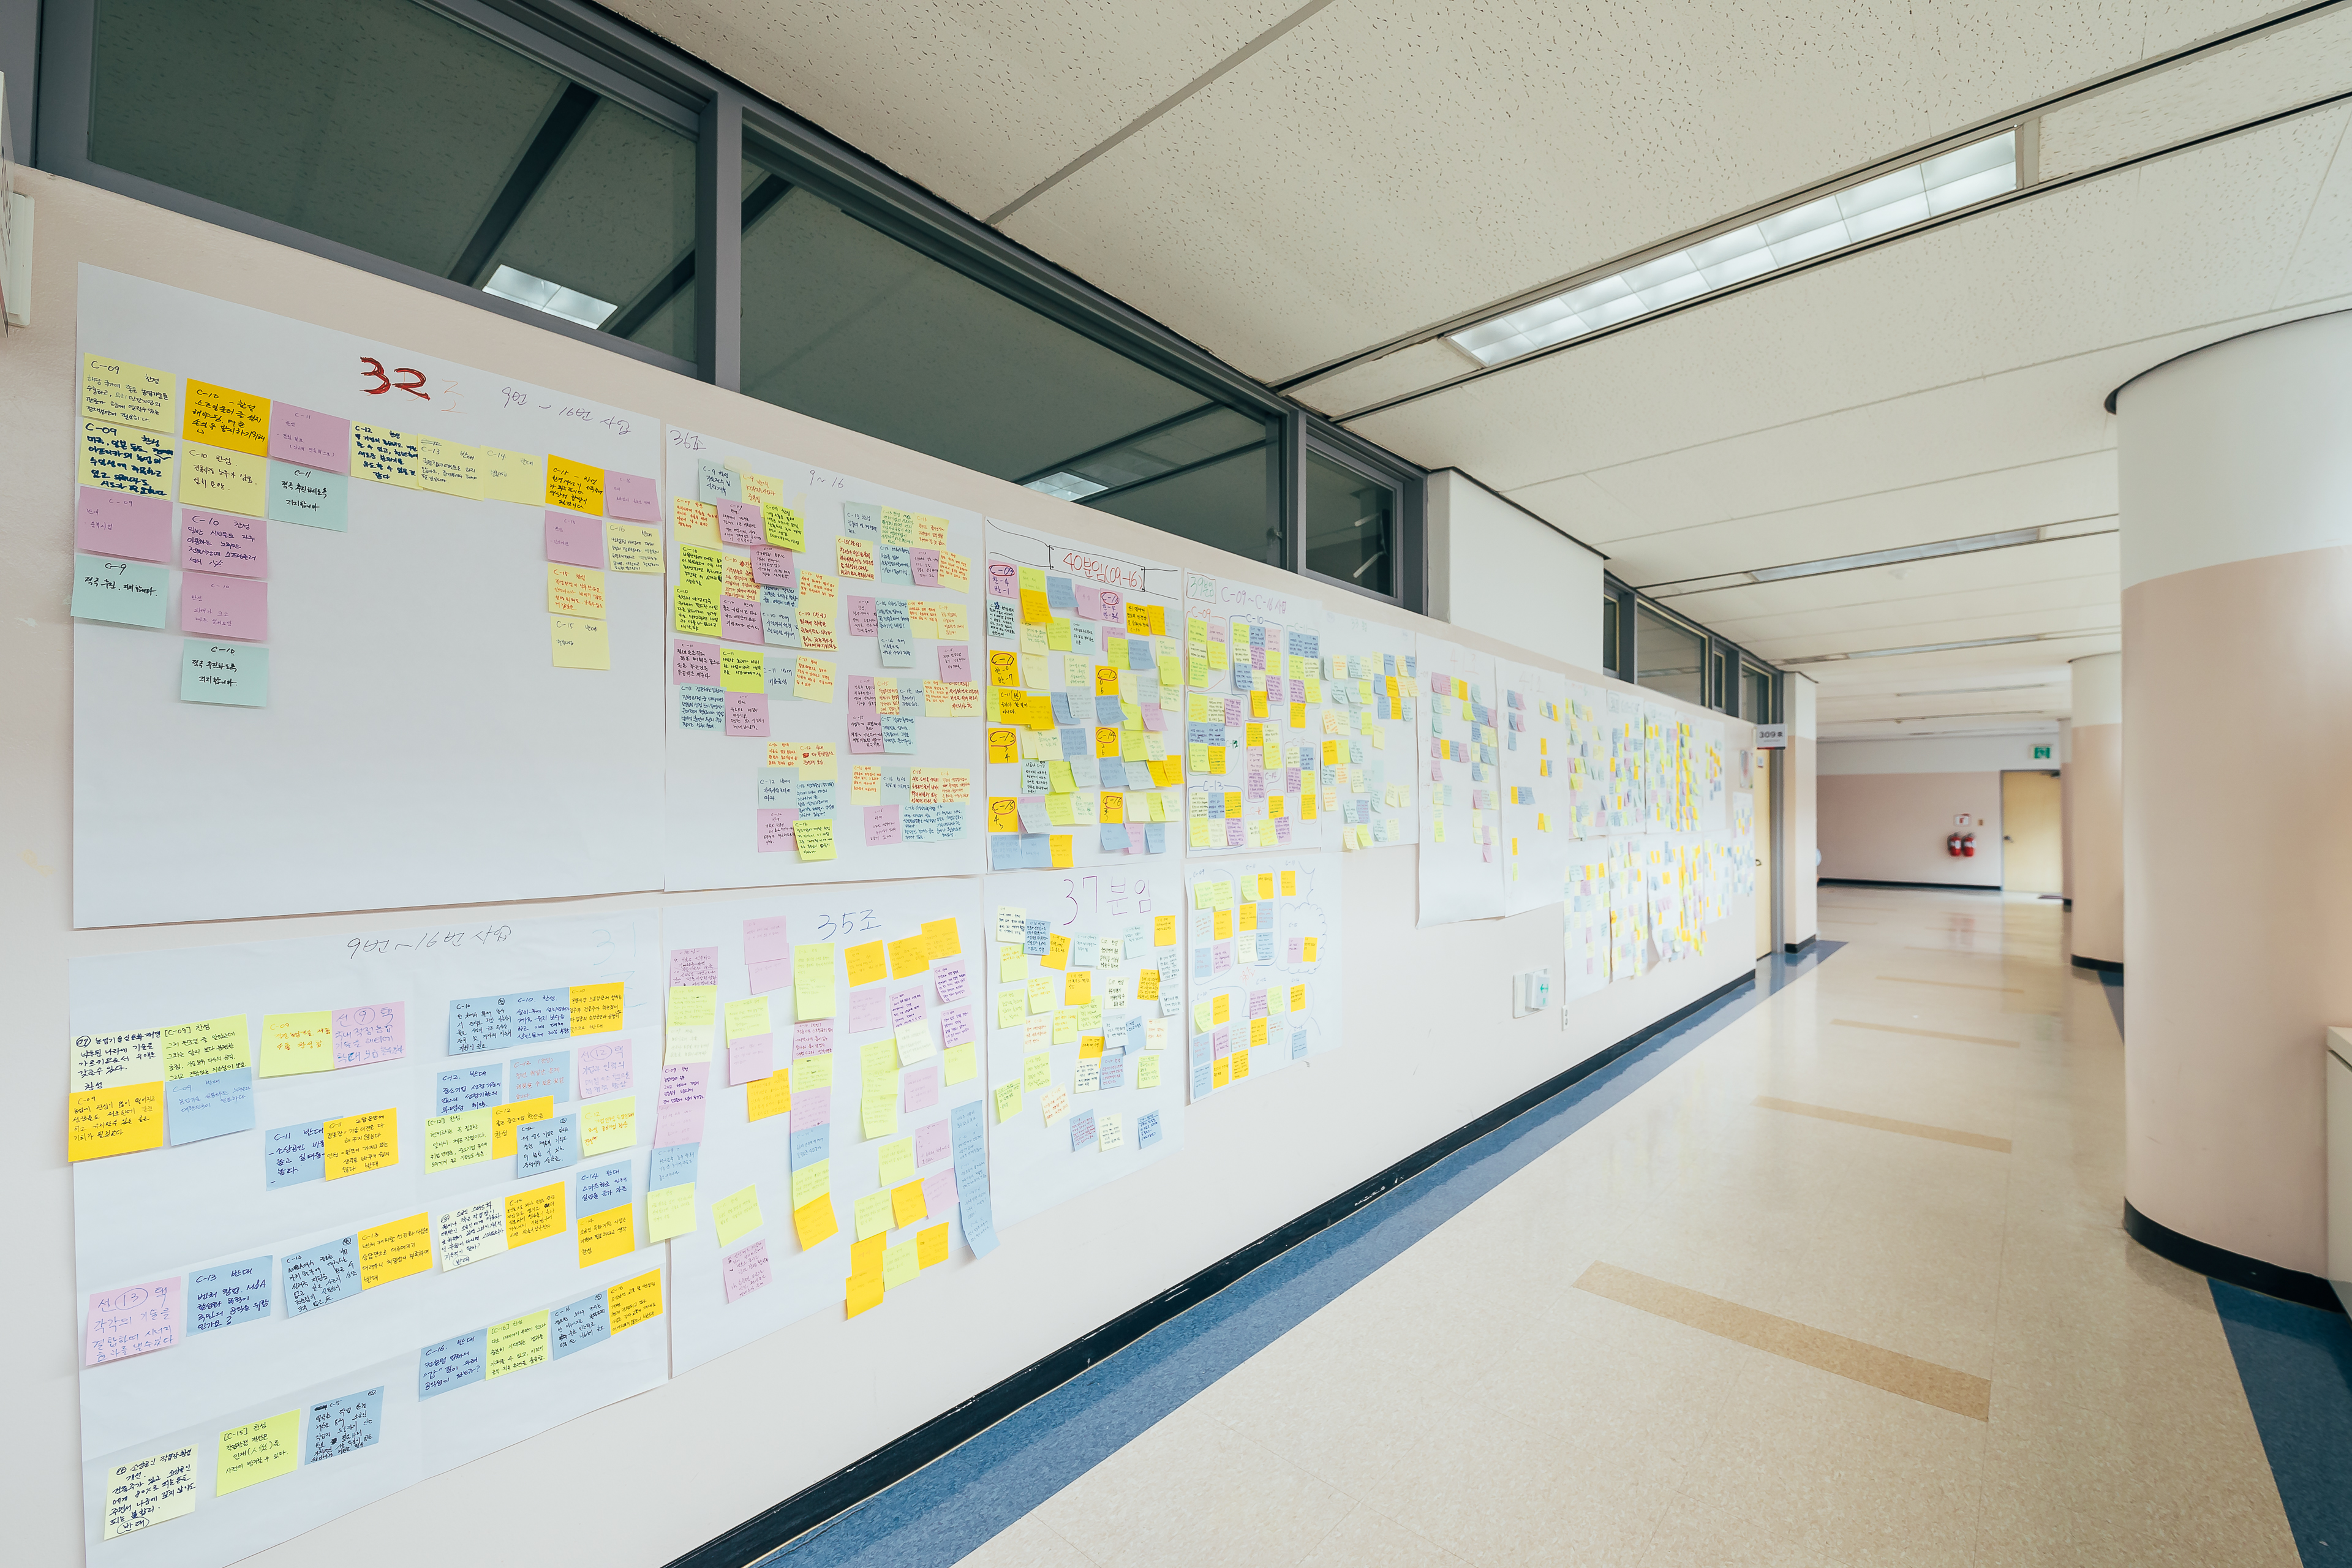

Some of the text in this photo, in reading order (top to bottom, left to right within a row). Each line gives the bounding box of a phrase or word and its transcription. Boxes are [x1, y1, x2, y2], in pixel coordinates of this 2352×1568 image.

[91, 361, 119, 375] C-09
[87, 374, 102, 385] 해당
[197, 389, 219, 399] C-10
[85, 423, 117, 436] C-09
[355, 425, 372, 434] C-12
[189, 450, 208, 459] C-10
[421, 447, 440, 455] C-13
[488, 450, 506, 461] C-14
[703, 466, 715, 475] C-9
[108, 498, 133, 507] C-09
[192, 515, 220, 527] C-10
[105, 562, 127, 575] C-9
[195, 1272, 217, 1284] C-13
[555, 1306, 570, 1316] C-16
